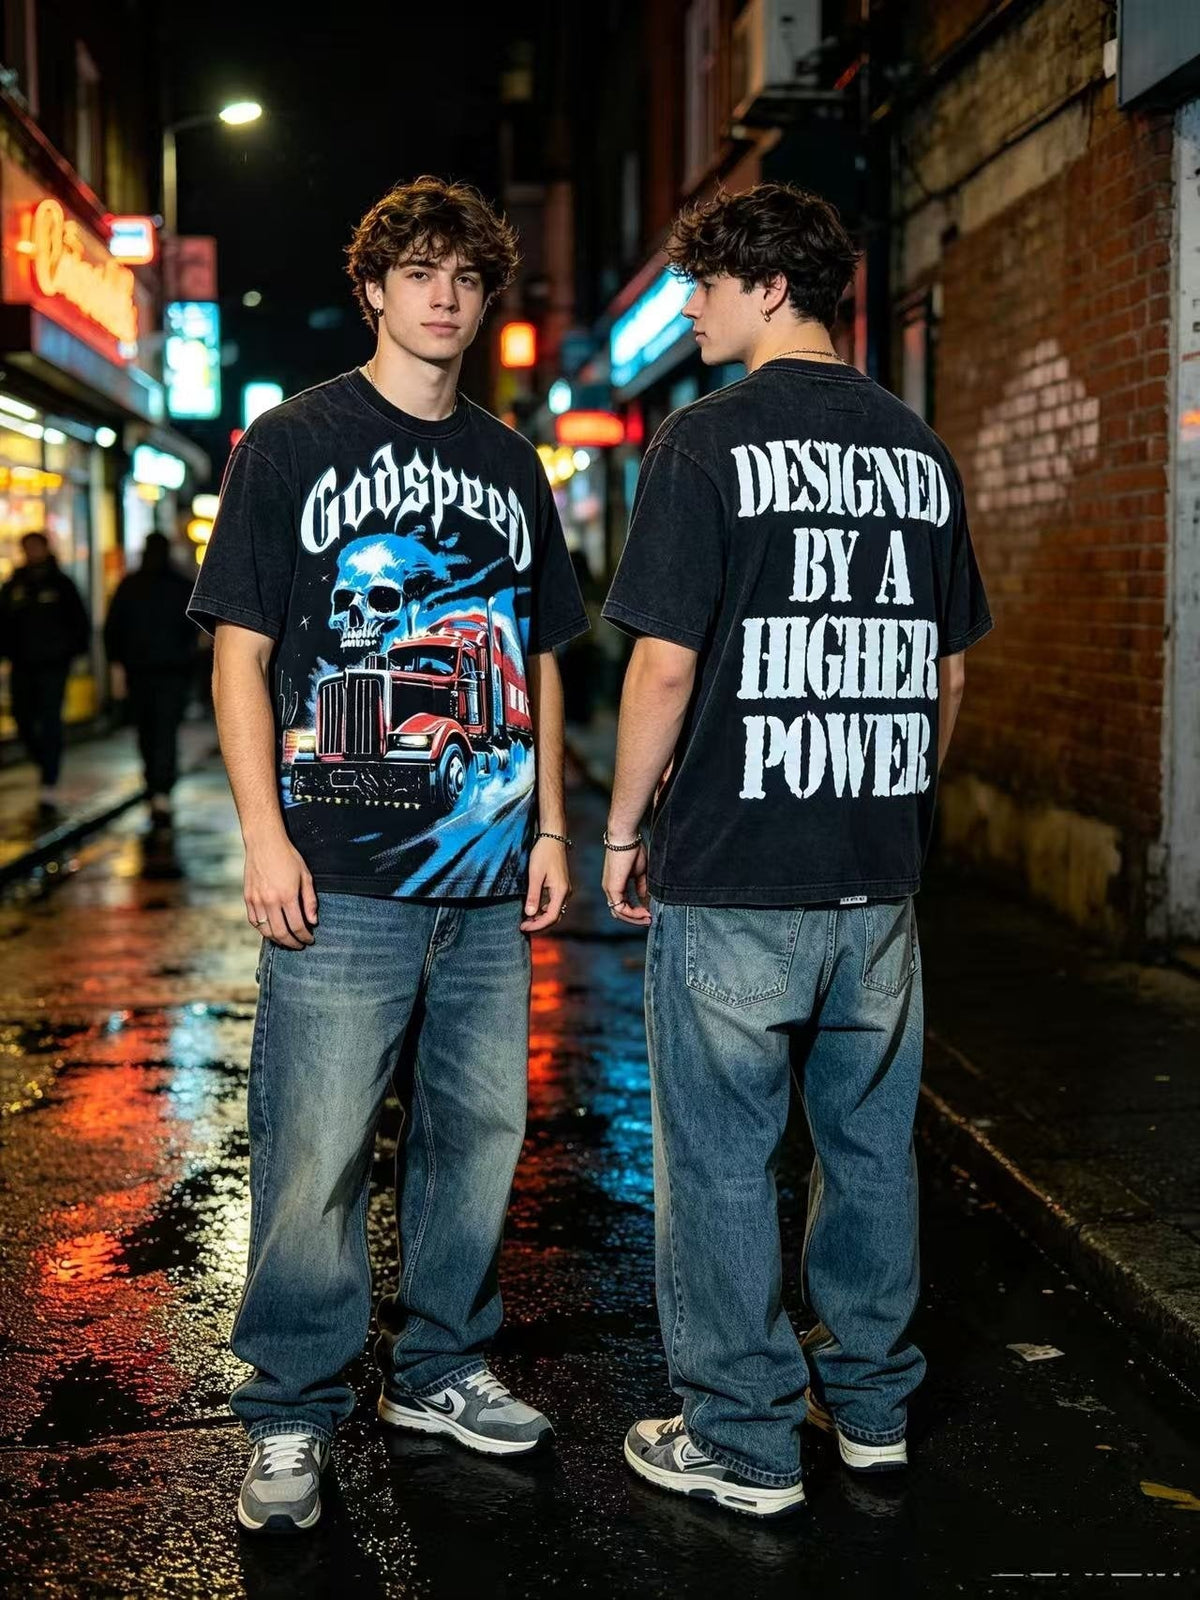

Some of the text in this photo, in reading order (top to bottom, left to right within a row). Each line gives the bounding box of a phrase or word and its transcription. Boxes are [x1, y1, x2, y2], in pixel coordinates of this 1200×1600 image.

[731, 439, 950, 527] DESIGNED
[789, 528, 914, 605] BY A
[737, 614, 938, 700] HIGHER
[739, 711, 930, 799] POWER
